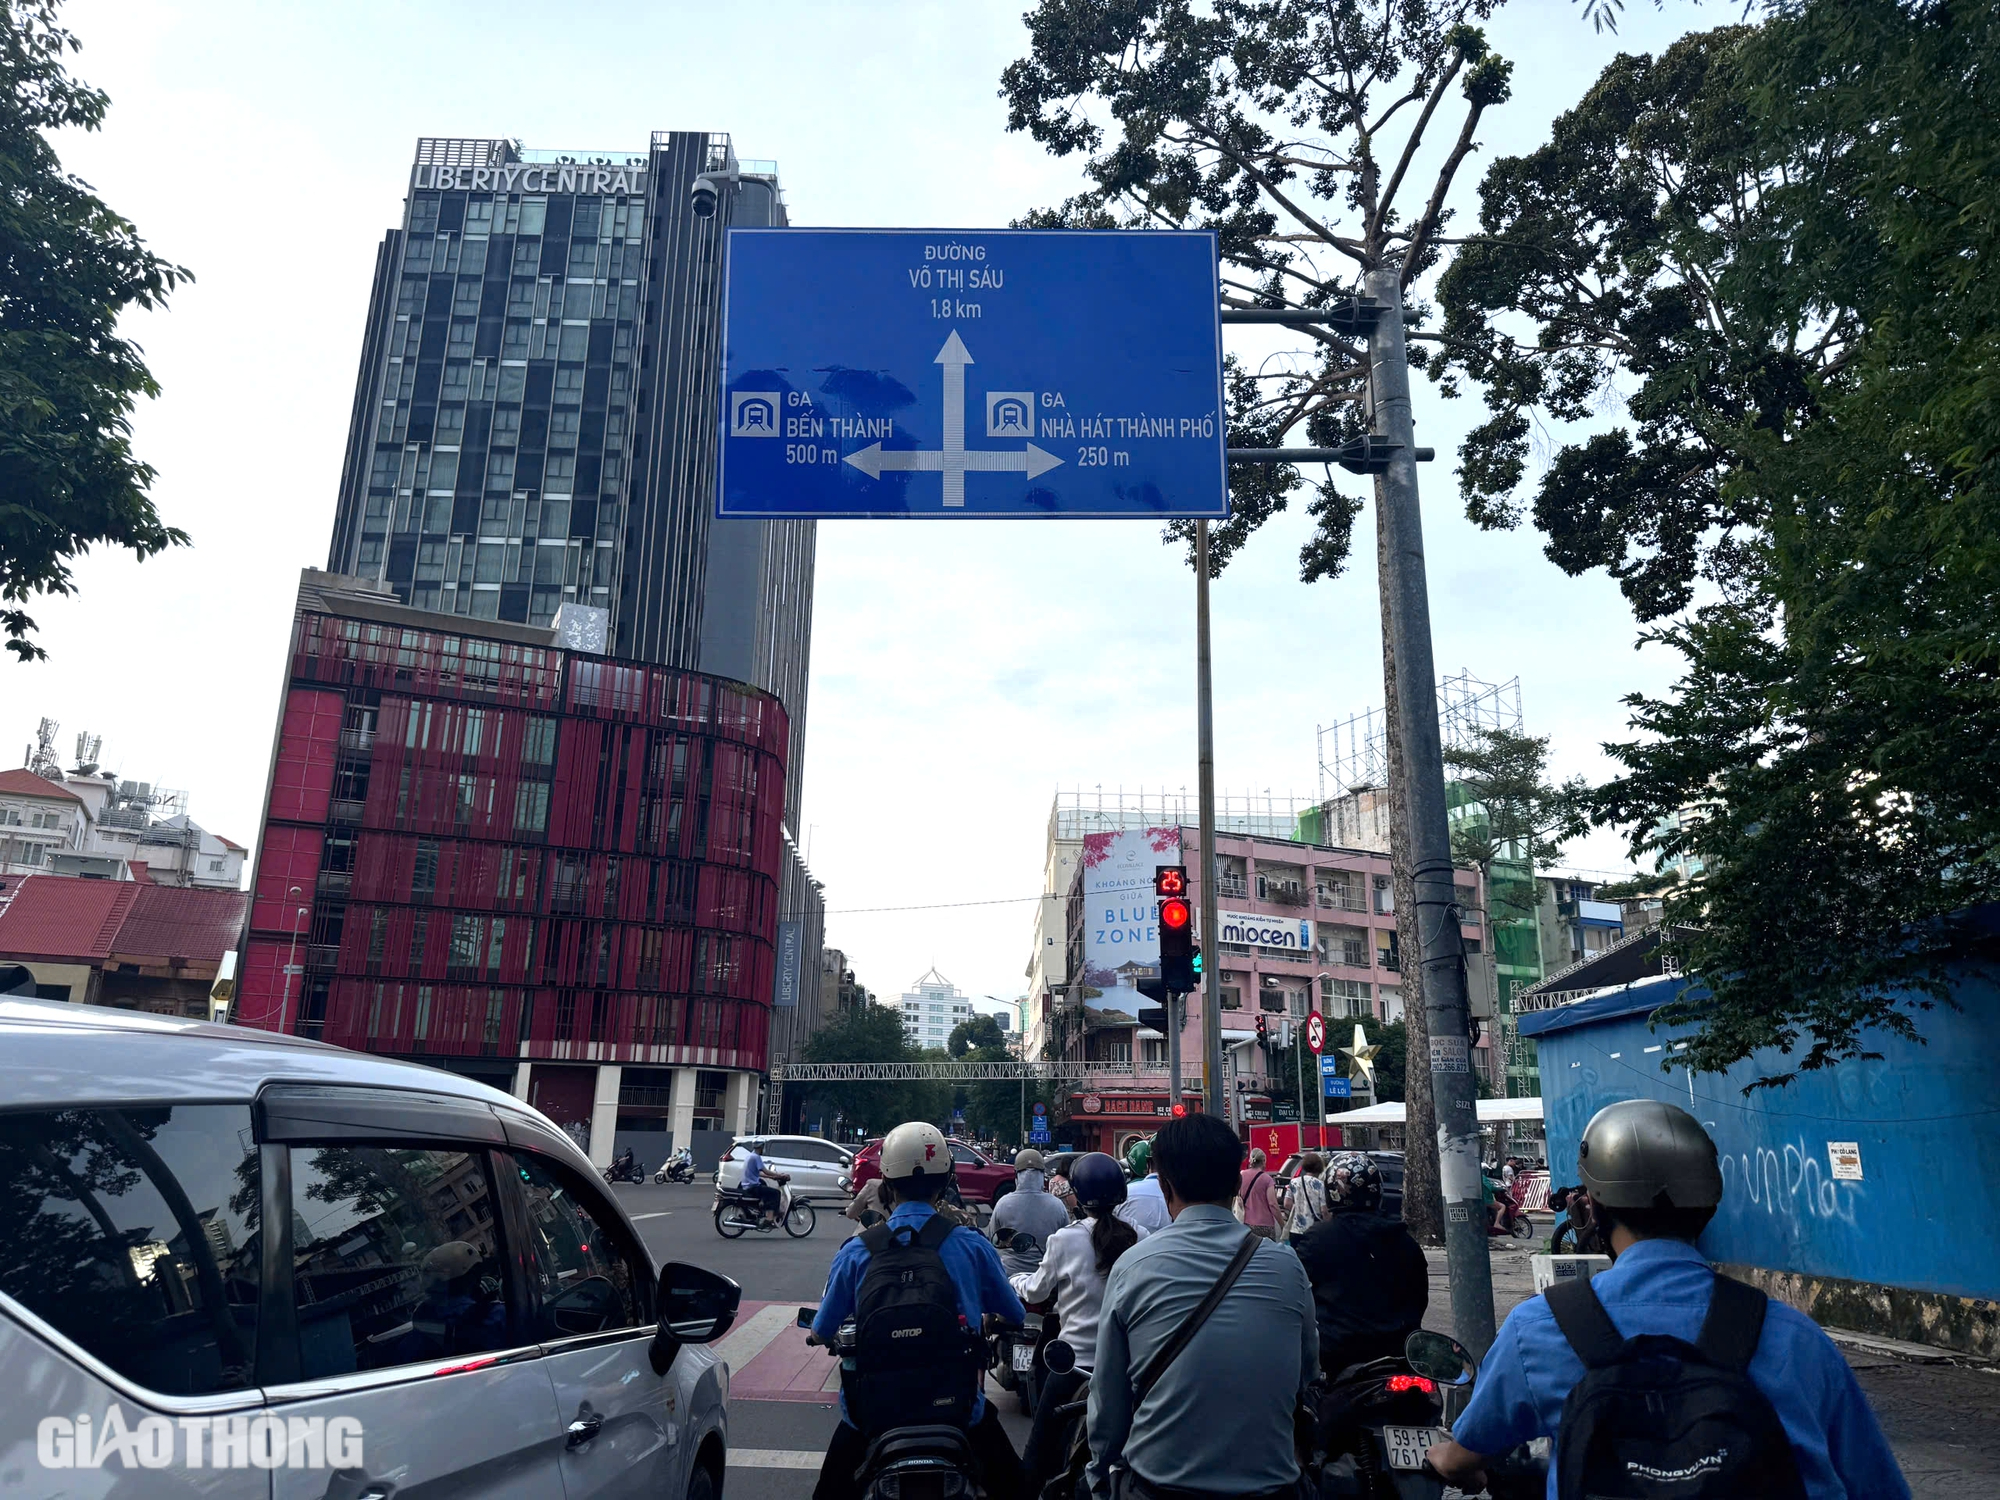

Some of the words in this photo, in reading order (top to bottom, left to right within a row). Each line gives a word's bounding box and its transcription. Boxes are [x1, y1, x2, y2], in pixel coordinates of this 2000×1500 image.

[414, 165, 522, 192] LIBERTY
[522, 167, 644, 195] CENTRAL
[924, 240, 986, 261] ĐƯỜNG
[908, 264, 931, 288] VÕ
[936, 269, 963, 293] THỊ
[969, 264, 1004, 289] SÁU
[931, 299, 951, 319] 1,8
[956, 299, 981, 318] km
[787, 391, 812, 407] GA
[1041, 392, 1066, 408] GA
[787, 409, 823, 438] BẾN
[829, 412, 893, 438] THÀNH
[1041, 412, 1076, 438] NHÀ
[1081, 412, 1113, 438] HÁT
[1117, 412, 1175, 438] THÀNH
[1180, 410, 1216, 438] PHỐ
[786, 444, 817, 464] 500
[822, 449, 838, 464] m
[1078, 446, 1108, 466] 250
[1114, 451, 1129, 466] m
[1162, 871, 1181, 890] 25
[1105, 906, 1159, 923] BLUE
[1095, 926, 1156, 944] ZONE
[1223, 920, 1295, 947] miocen
[784, 927, 795, 966] CENTRAL
[781, 967, 792, 1000] LIBERTY
[1329, 1086, 1337, 1094] LÊ
[891, 1327, 922, 1338] ONTOP
